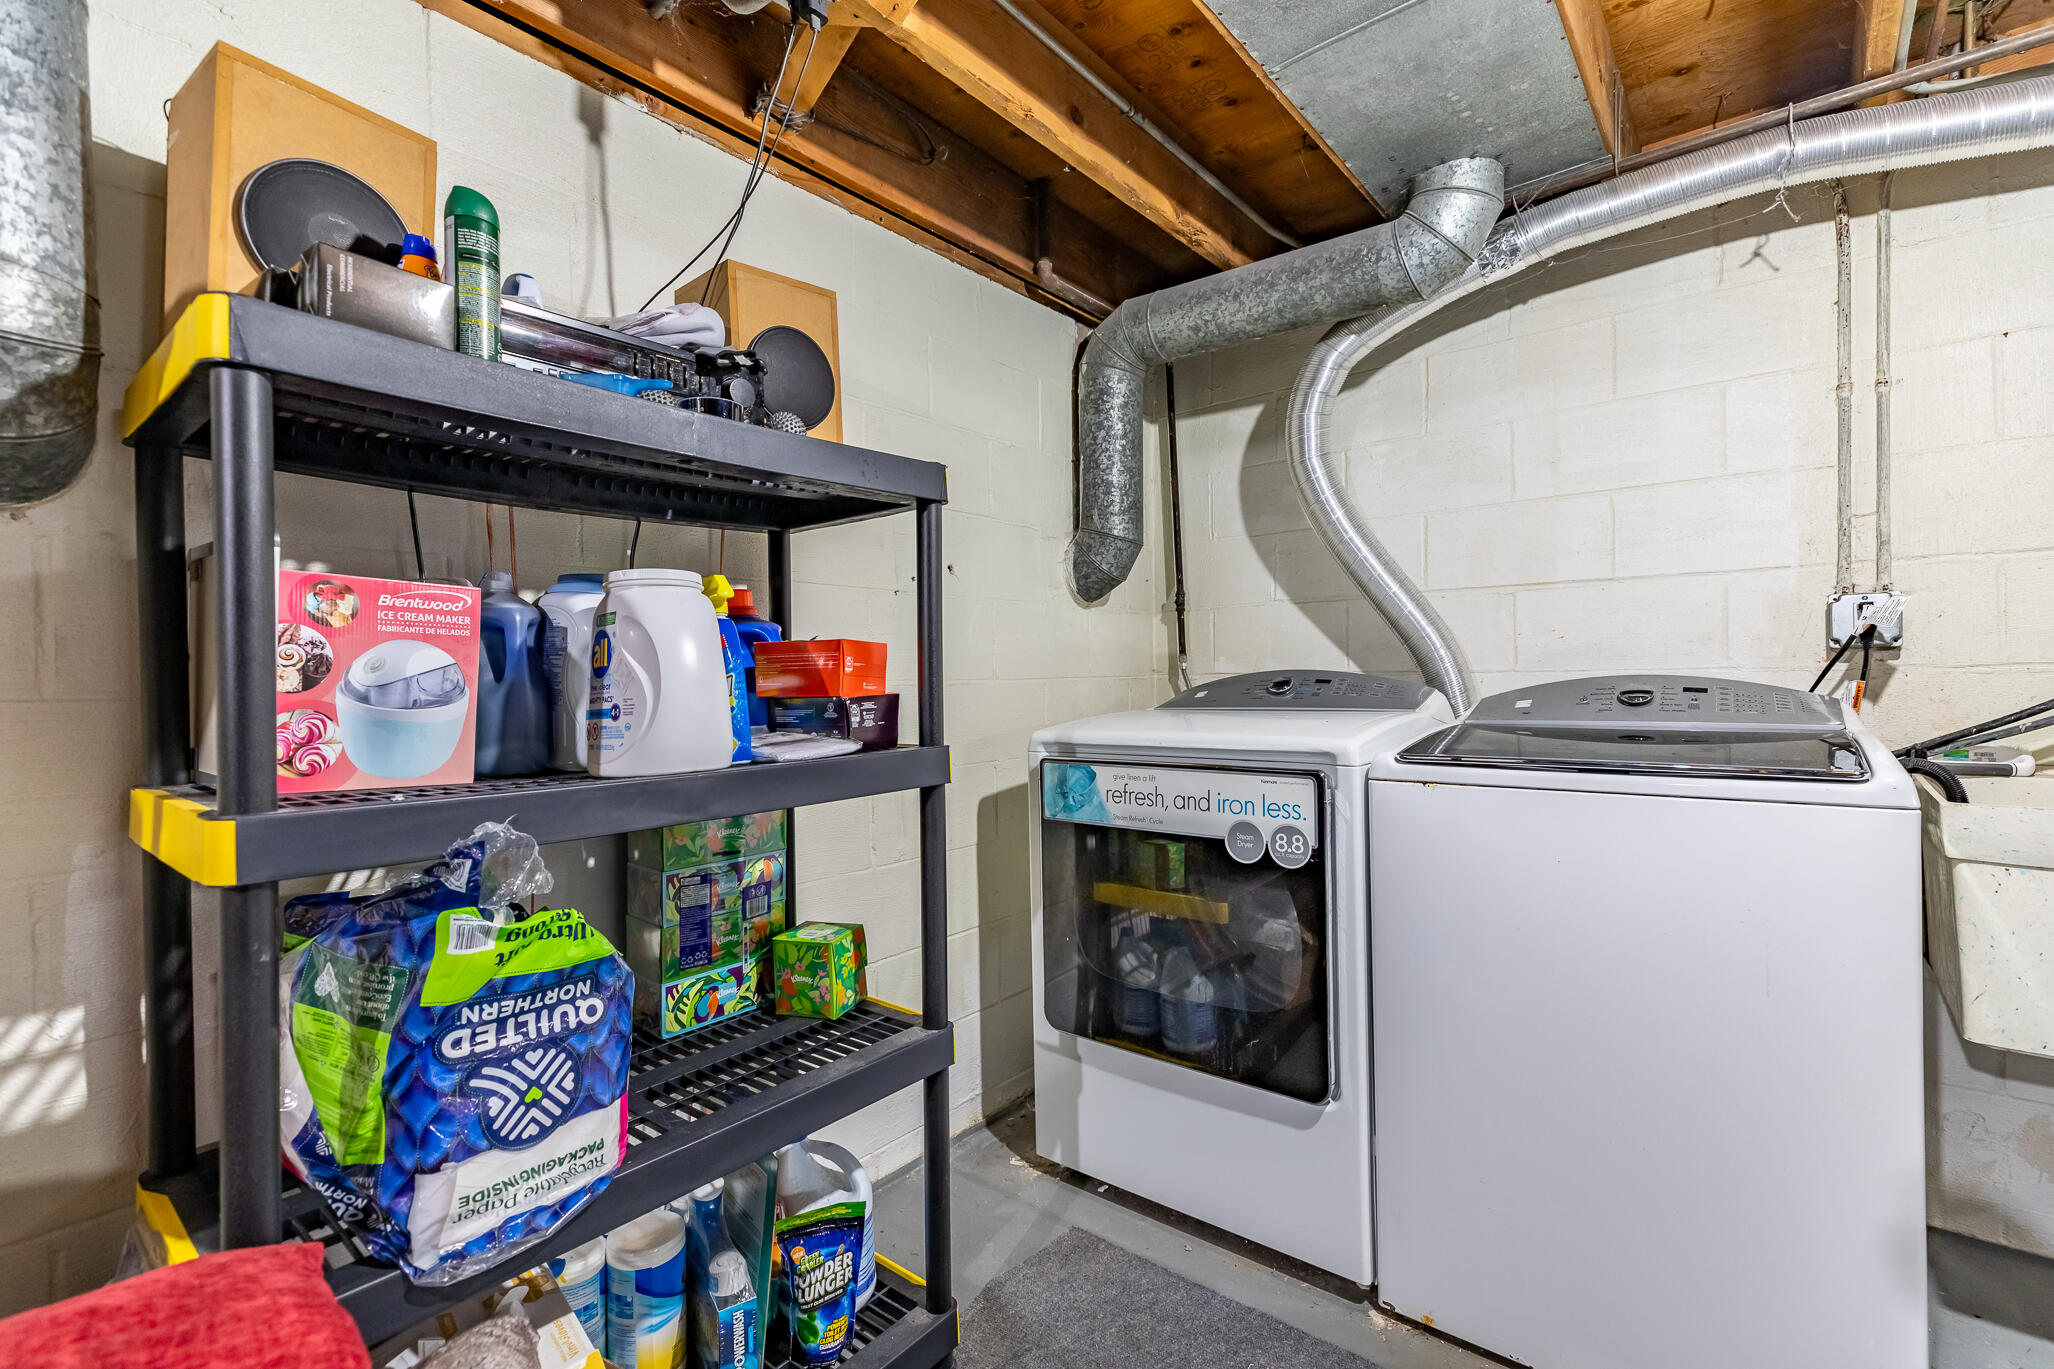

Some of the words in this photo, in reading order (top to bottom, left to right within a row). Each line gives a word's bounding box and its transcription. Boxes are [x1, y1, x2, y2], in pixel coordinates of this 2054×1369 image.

[377, 610, 394, 620] ICE
[397, 611, 434, 622] CREAM
[436, 614, 471, 625] MAKER
[378, 594, 465, 611] Brentwood
[377, 624, 424, 633] FABRICANTE
[594, 638, 608, 669] all
[1106, 783, 1169, 811] refresh,
[1173, 789, 1211, 812] and
[1217, 792, 1255, 816] iron
[1262, 793, 1307, 821] less.
[1236, 832, 1254, 841] Steam
[1237, 840, 1254, 849] Dryer
[1275, 833, 1304, 854] 8.8
[462, 979, 591, 1025] NORTHERN
[441, 997, 604, 1059] QUILTED
[519, 1138, 605, 1182] PACKAGING
[458, 1174, 519, 1209] INSIDE
[452, 1193, 518, 1224] Paper
[793, 1251, 853, 1290] POWDER
[733, 1309, 746, 1369] OWERWASH
